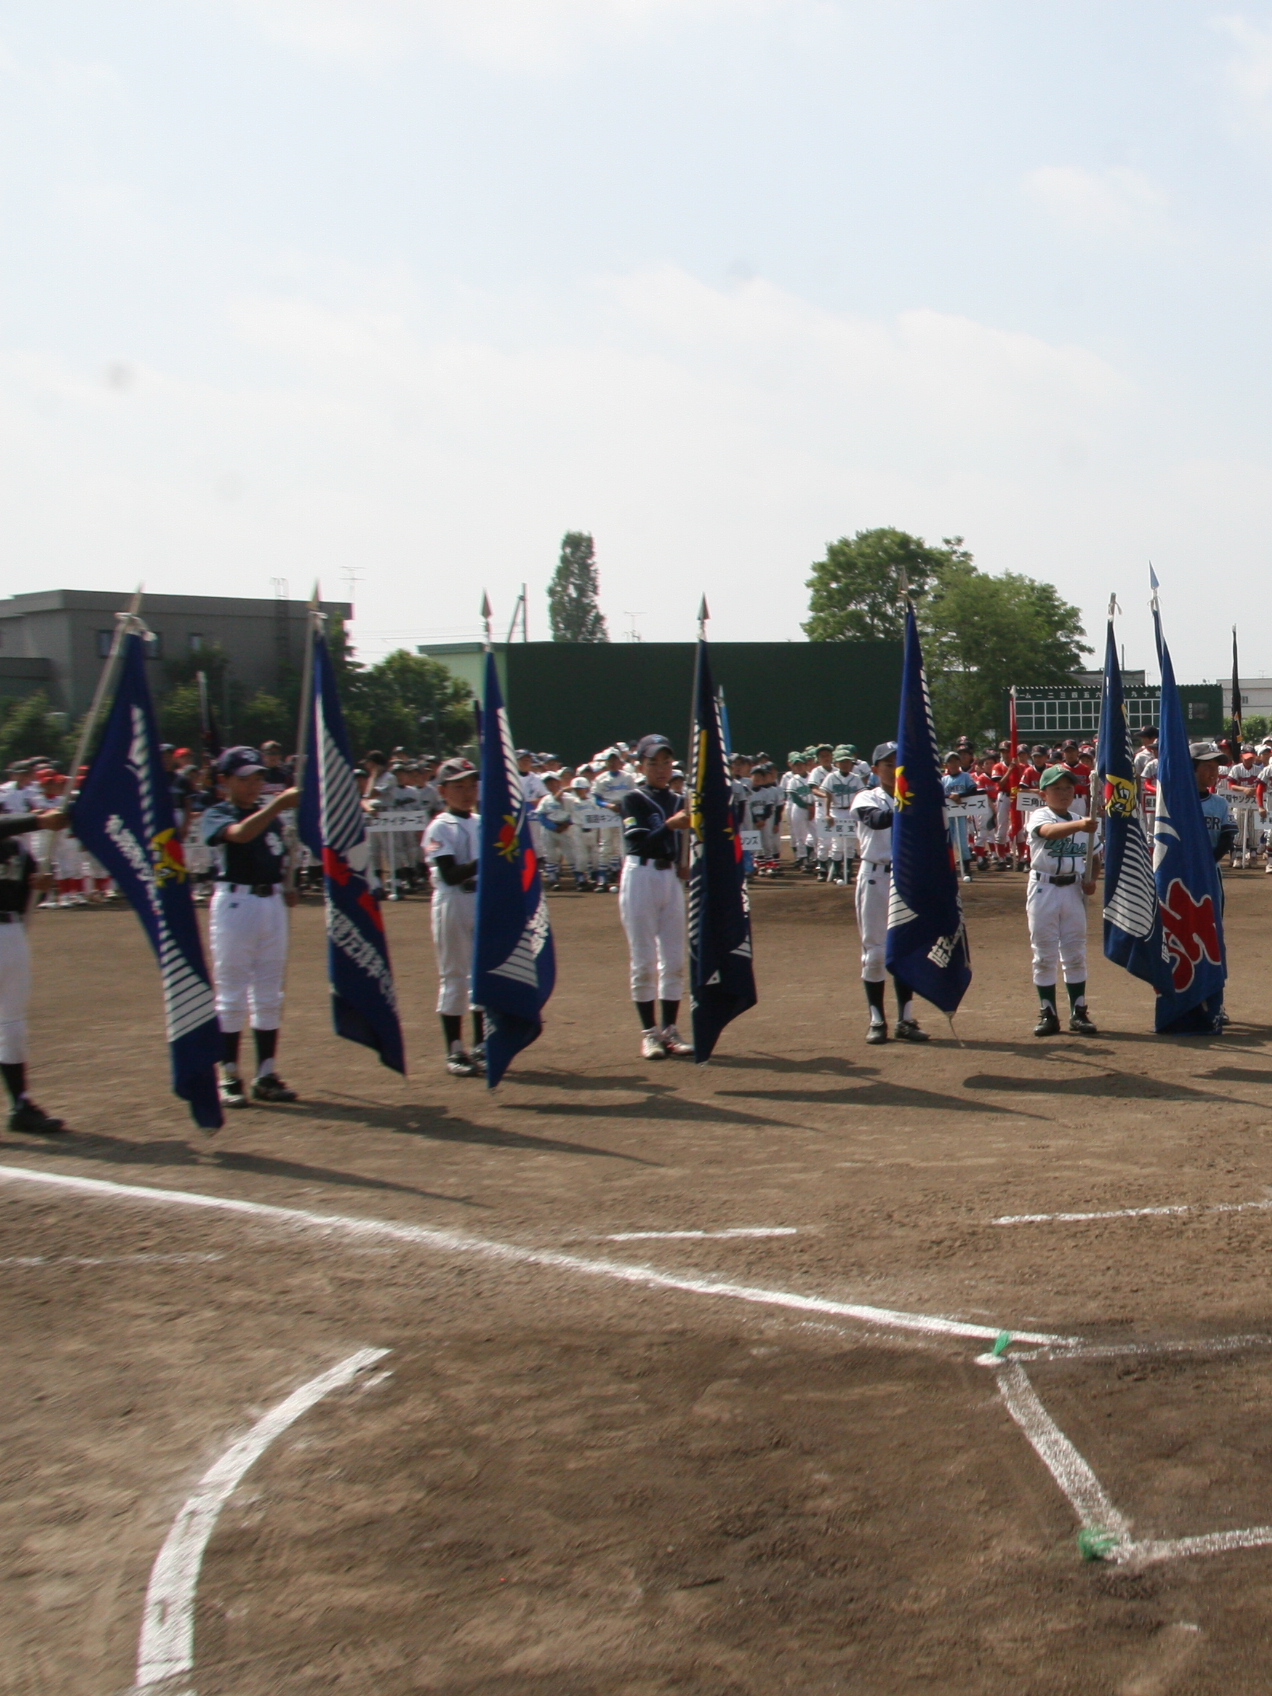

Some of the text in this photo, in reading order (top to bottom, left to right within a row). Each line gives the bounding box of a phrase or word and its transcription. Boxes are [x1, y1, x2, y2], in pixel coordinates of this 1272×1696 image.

[365, 815, 425, 827] ファイターズ
